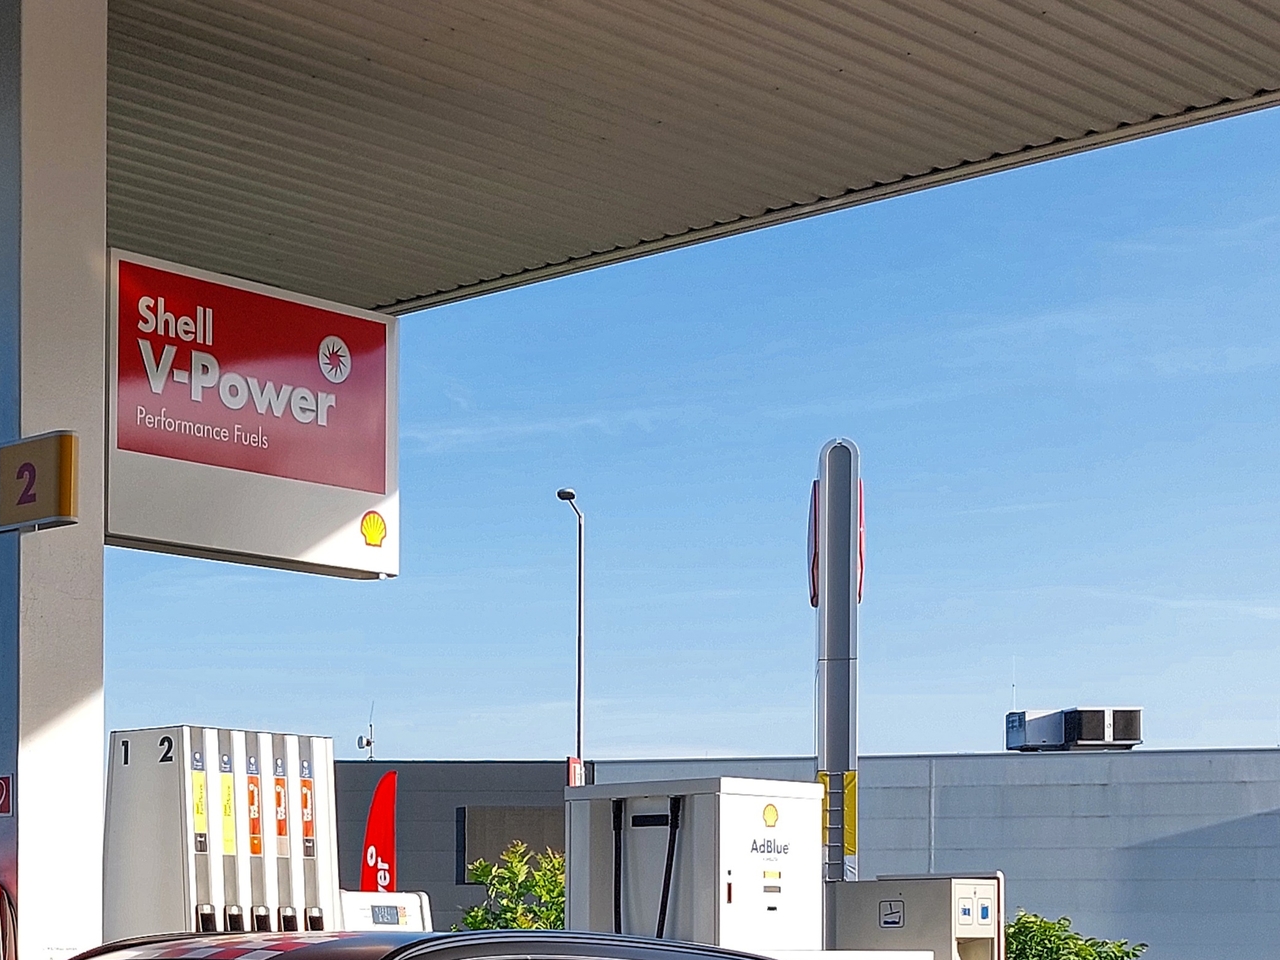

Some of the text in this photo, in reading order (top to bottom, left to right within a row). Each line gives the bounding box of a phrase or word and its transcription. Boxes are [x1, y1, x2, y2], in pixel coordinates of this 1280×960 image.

[137, 296, 213, 346] Shell
[137, 337, 336, 427] V-Power
[136, 405, 269, 449] Performance Fuels
[16, 462, 37, 506] 2
[121, 735, 174, 765] 1 2
[750, 838, 787, 855] AdBlue
